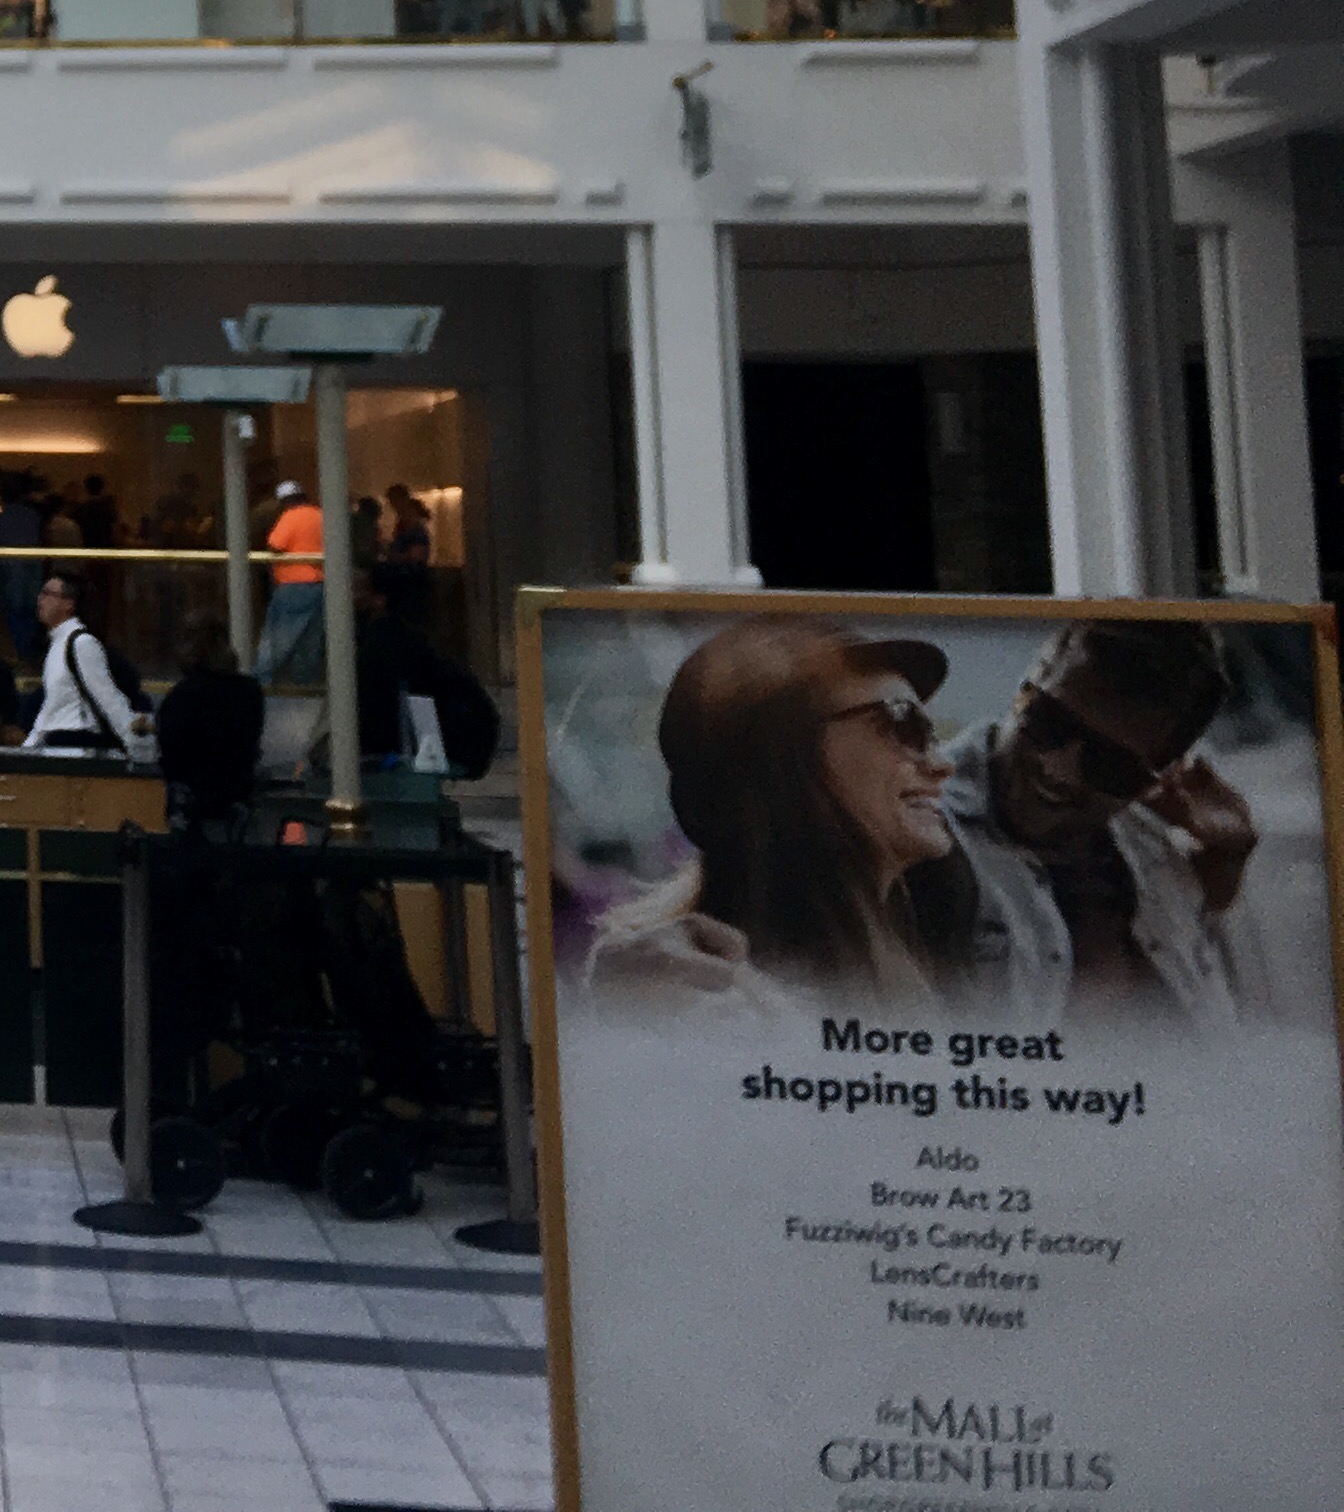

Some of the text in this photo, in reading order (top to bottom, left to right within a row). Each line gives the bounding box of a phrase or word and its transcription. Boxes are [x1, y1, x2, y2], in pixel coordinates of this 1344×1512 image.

[821, 1017, 1064, 1067] More great
[741, 1065, 1146, 1125] shopping this way!
[915, 1145, 980, 1172] Aldo
[870, 1180, 1032, 1213] Brow Art 23
[926, 1223, 1012, 1256] Candy
[1022, 1226, 1123, 1263] Factory
[870, 1258, 1040, 1290] LensCrafters
[887, 1298, 1028, 1329] Nine West
[911, 1394, 1042, 1442] MALL
